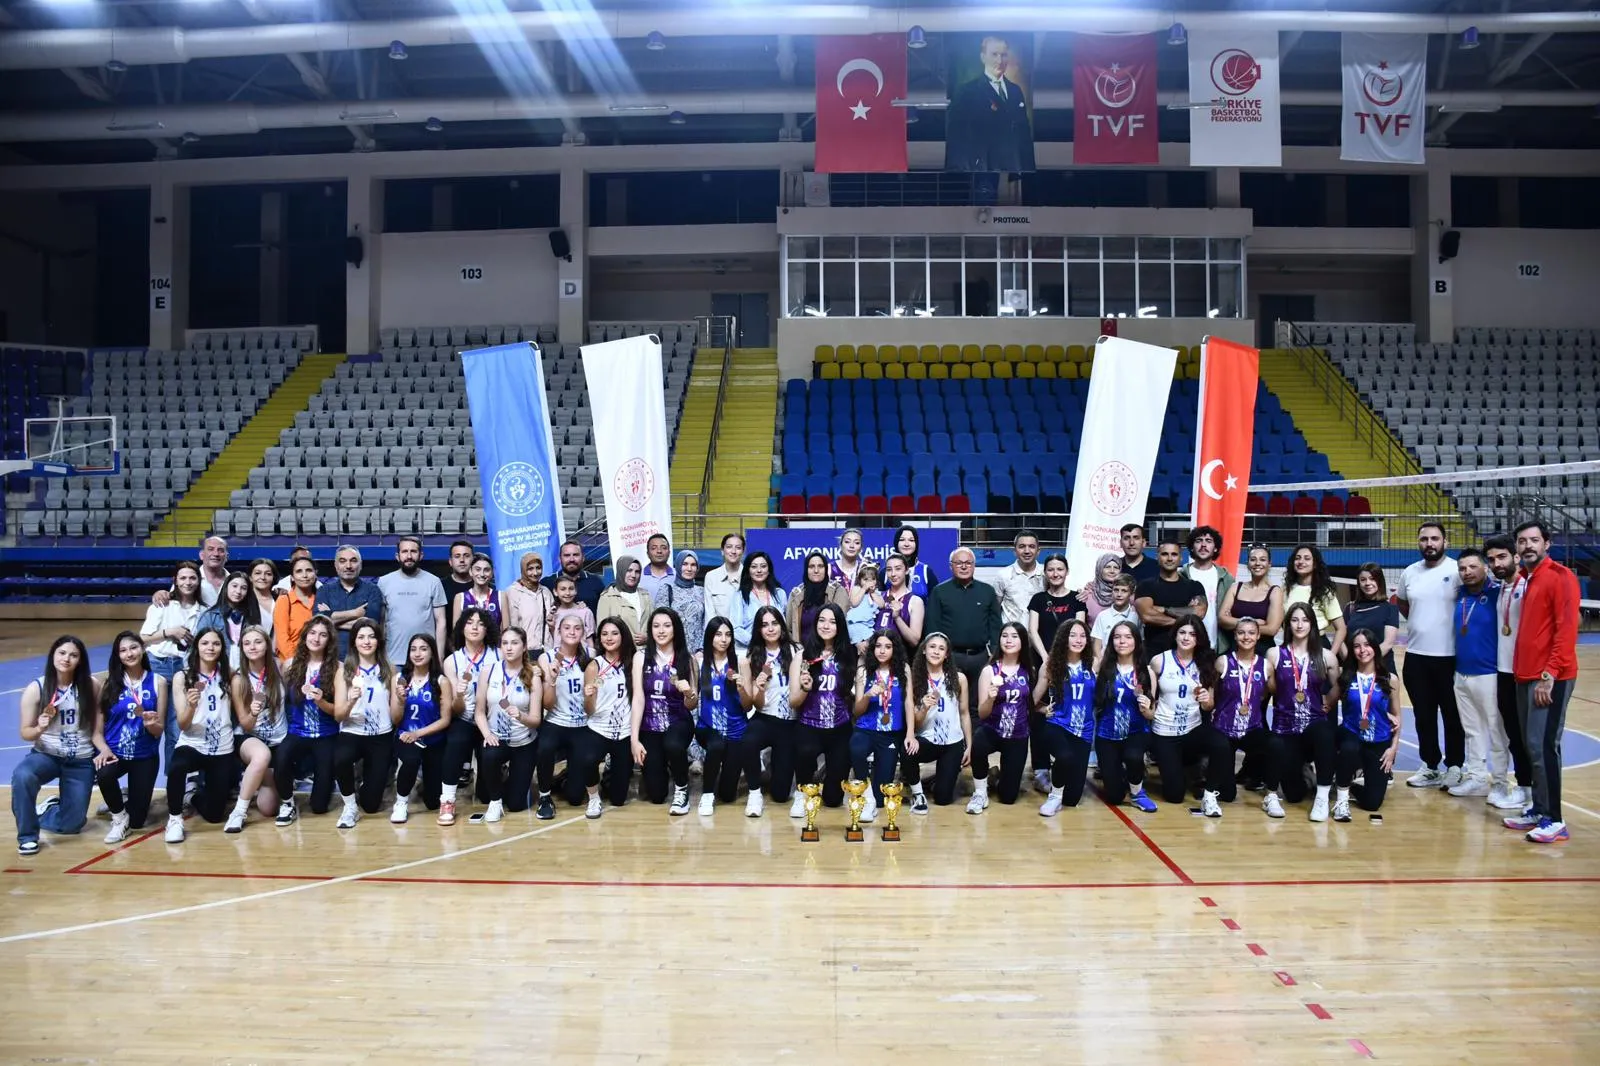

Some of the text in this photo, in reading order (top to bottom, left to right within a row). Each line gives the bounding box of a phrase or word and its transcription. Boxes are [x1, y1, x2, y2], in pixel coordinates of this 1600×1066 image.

[1087, 114, 1145, 137] TVF
[1354, 112, 1411, 137] TVF
[993, 216, 1031, 224] PROTOKOL
[460, 268, 482, 280] 103
[1518, 264, 1540, 276] 102
[151, 278, 170, 290] 104
[564, 282, 577, 296] D
[1435, 280, 1448, 293] B
[155, 296, 166, 309] E
[881, 612, 890, 627] 6
[567, 678, 581, 694] 15
[617, 683, 625, 699] 5
[653, 679, 664, 695] 9
[818, 674, 837, 692] 20
[1178, 683, 1188, 699] 8
[366, 687, 374, 703] 7
[712, 685, 721, 701] 6
[1004, 689, 1020, 704] 12
[1071, 683, 1085, 700] 17
[1117, 687, 1124, 703] 7
[207, 694, 217, 712] 3
[59, 708, 76, 726] 13
[410, 704, 419, 720] 2
